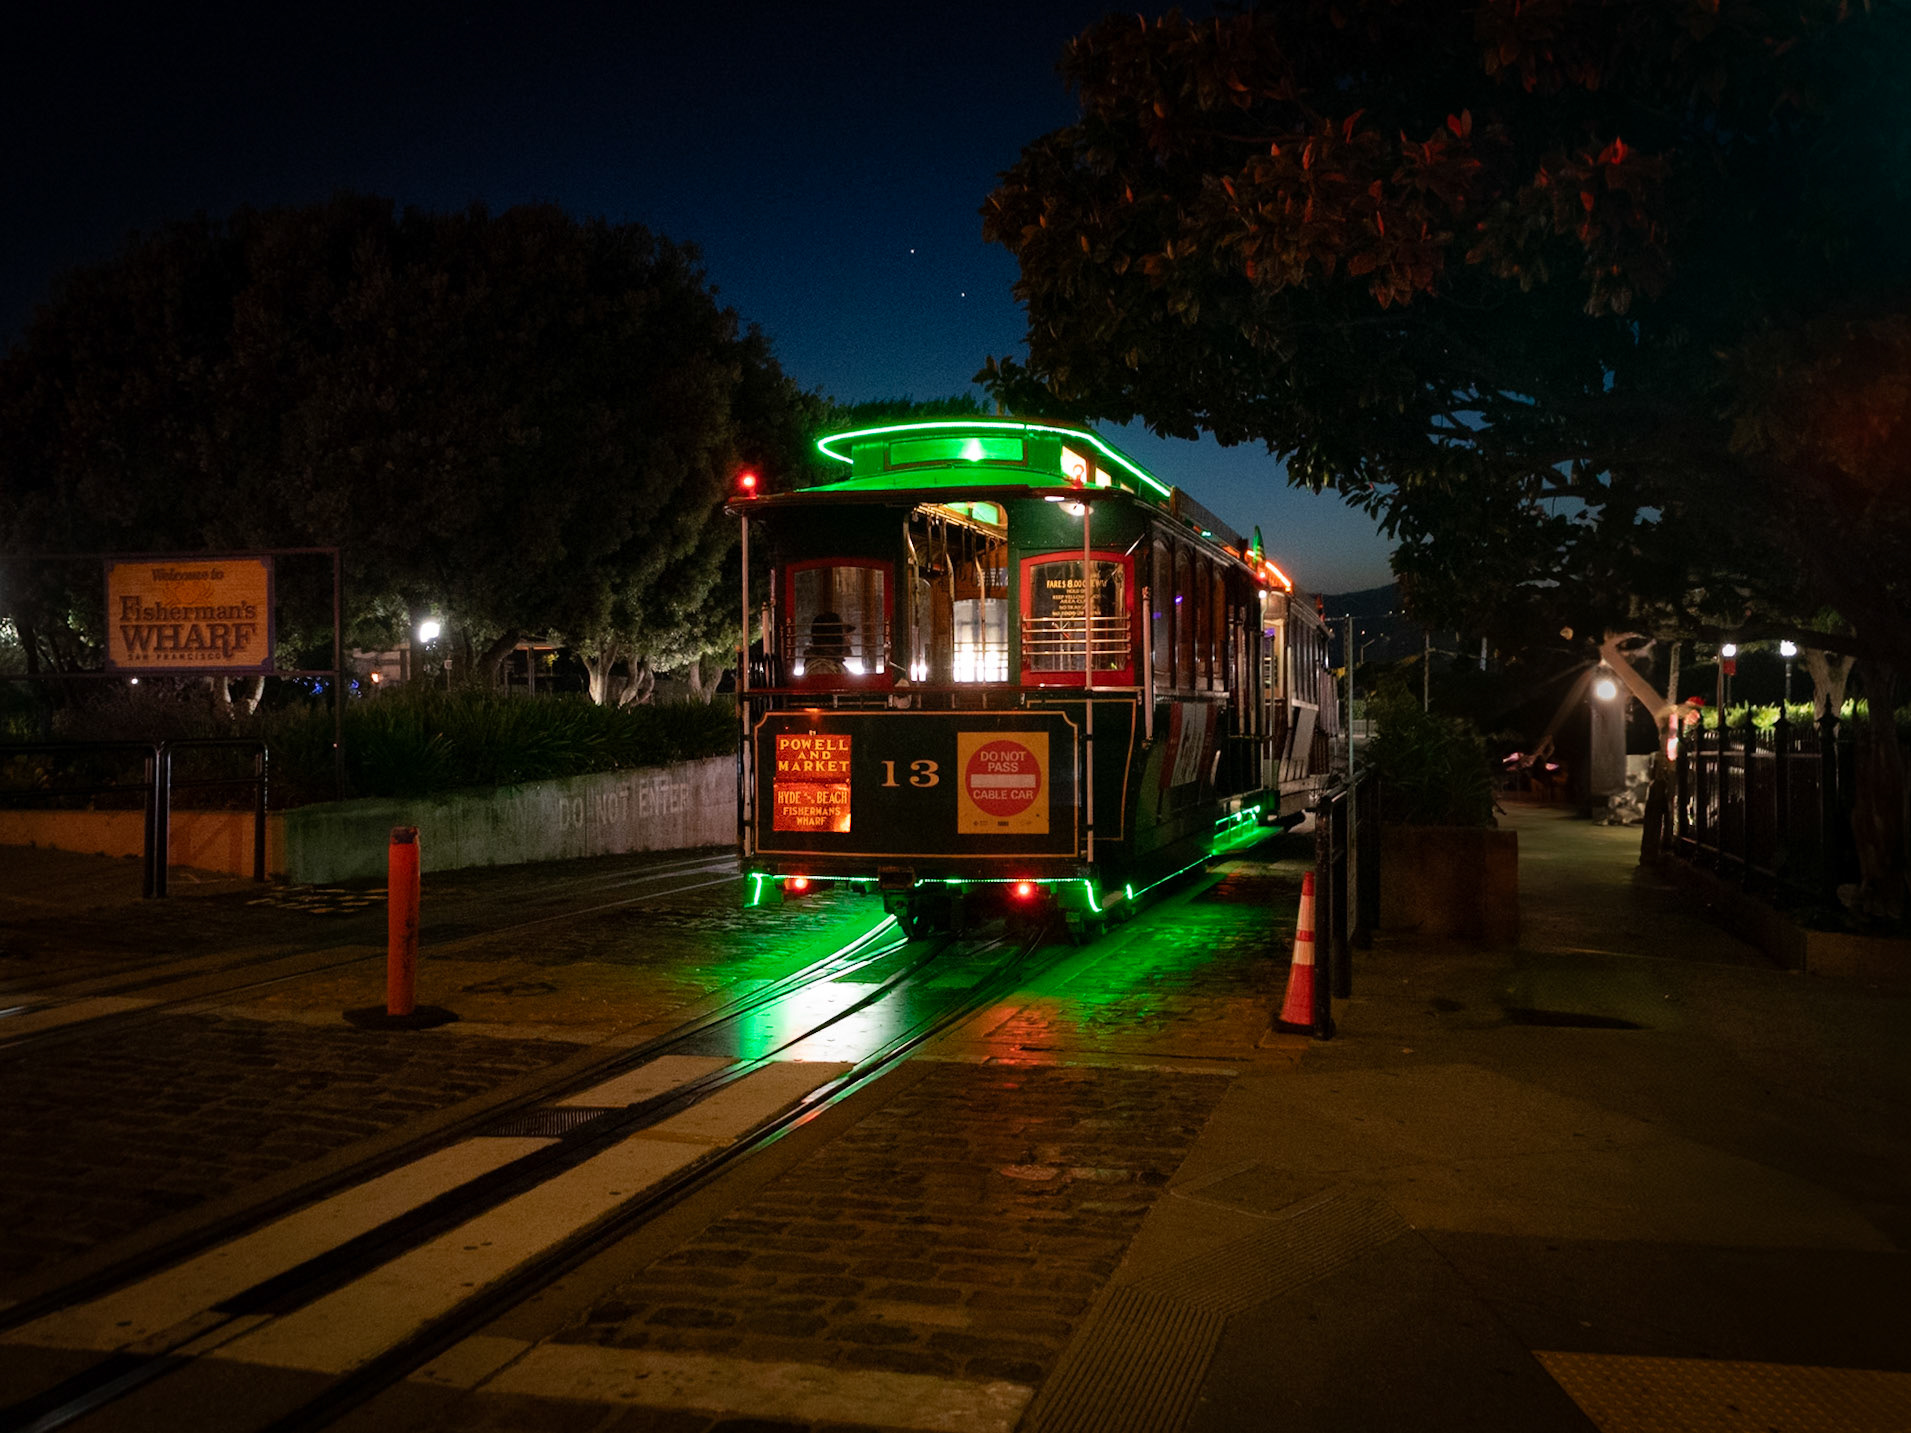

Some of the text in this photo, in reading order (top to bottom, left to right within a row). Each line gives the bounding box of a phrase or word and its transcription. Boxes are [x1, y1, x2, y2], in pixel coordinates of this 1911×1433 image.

[152, 567, 225, 582] Welcome to
[1046, 579, 1066, 589] FARES
[119, 595, 257, 622] Fisherman's
[119, 623, 257, 658] WHARF
[156, 652, 222, 660] FRANCISCO
[779, 738, 849, 751] POWELL
[797, 750, 832, 760] AND
[980, 751, 1027, 762] DO NOT
[778, 760, 850, 772] MARKET
[987, 762, 1019, 773] PASS
[880, 759, 941, 788] 13
[777, 790, 802, 804] HYDE
[816, 790, 848, 805] BEACH
[972, 789, 1034, 801] CABLE CAR
[558, 782, 690, 831] DO NOT ENTER
[782, 806, 842, 816] FISHERMANS
[796, 816, 827, 826] WHARF
